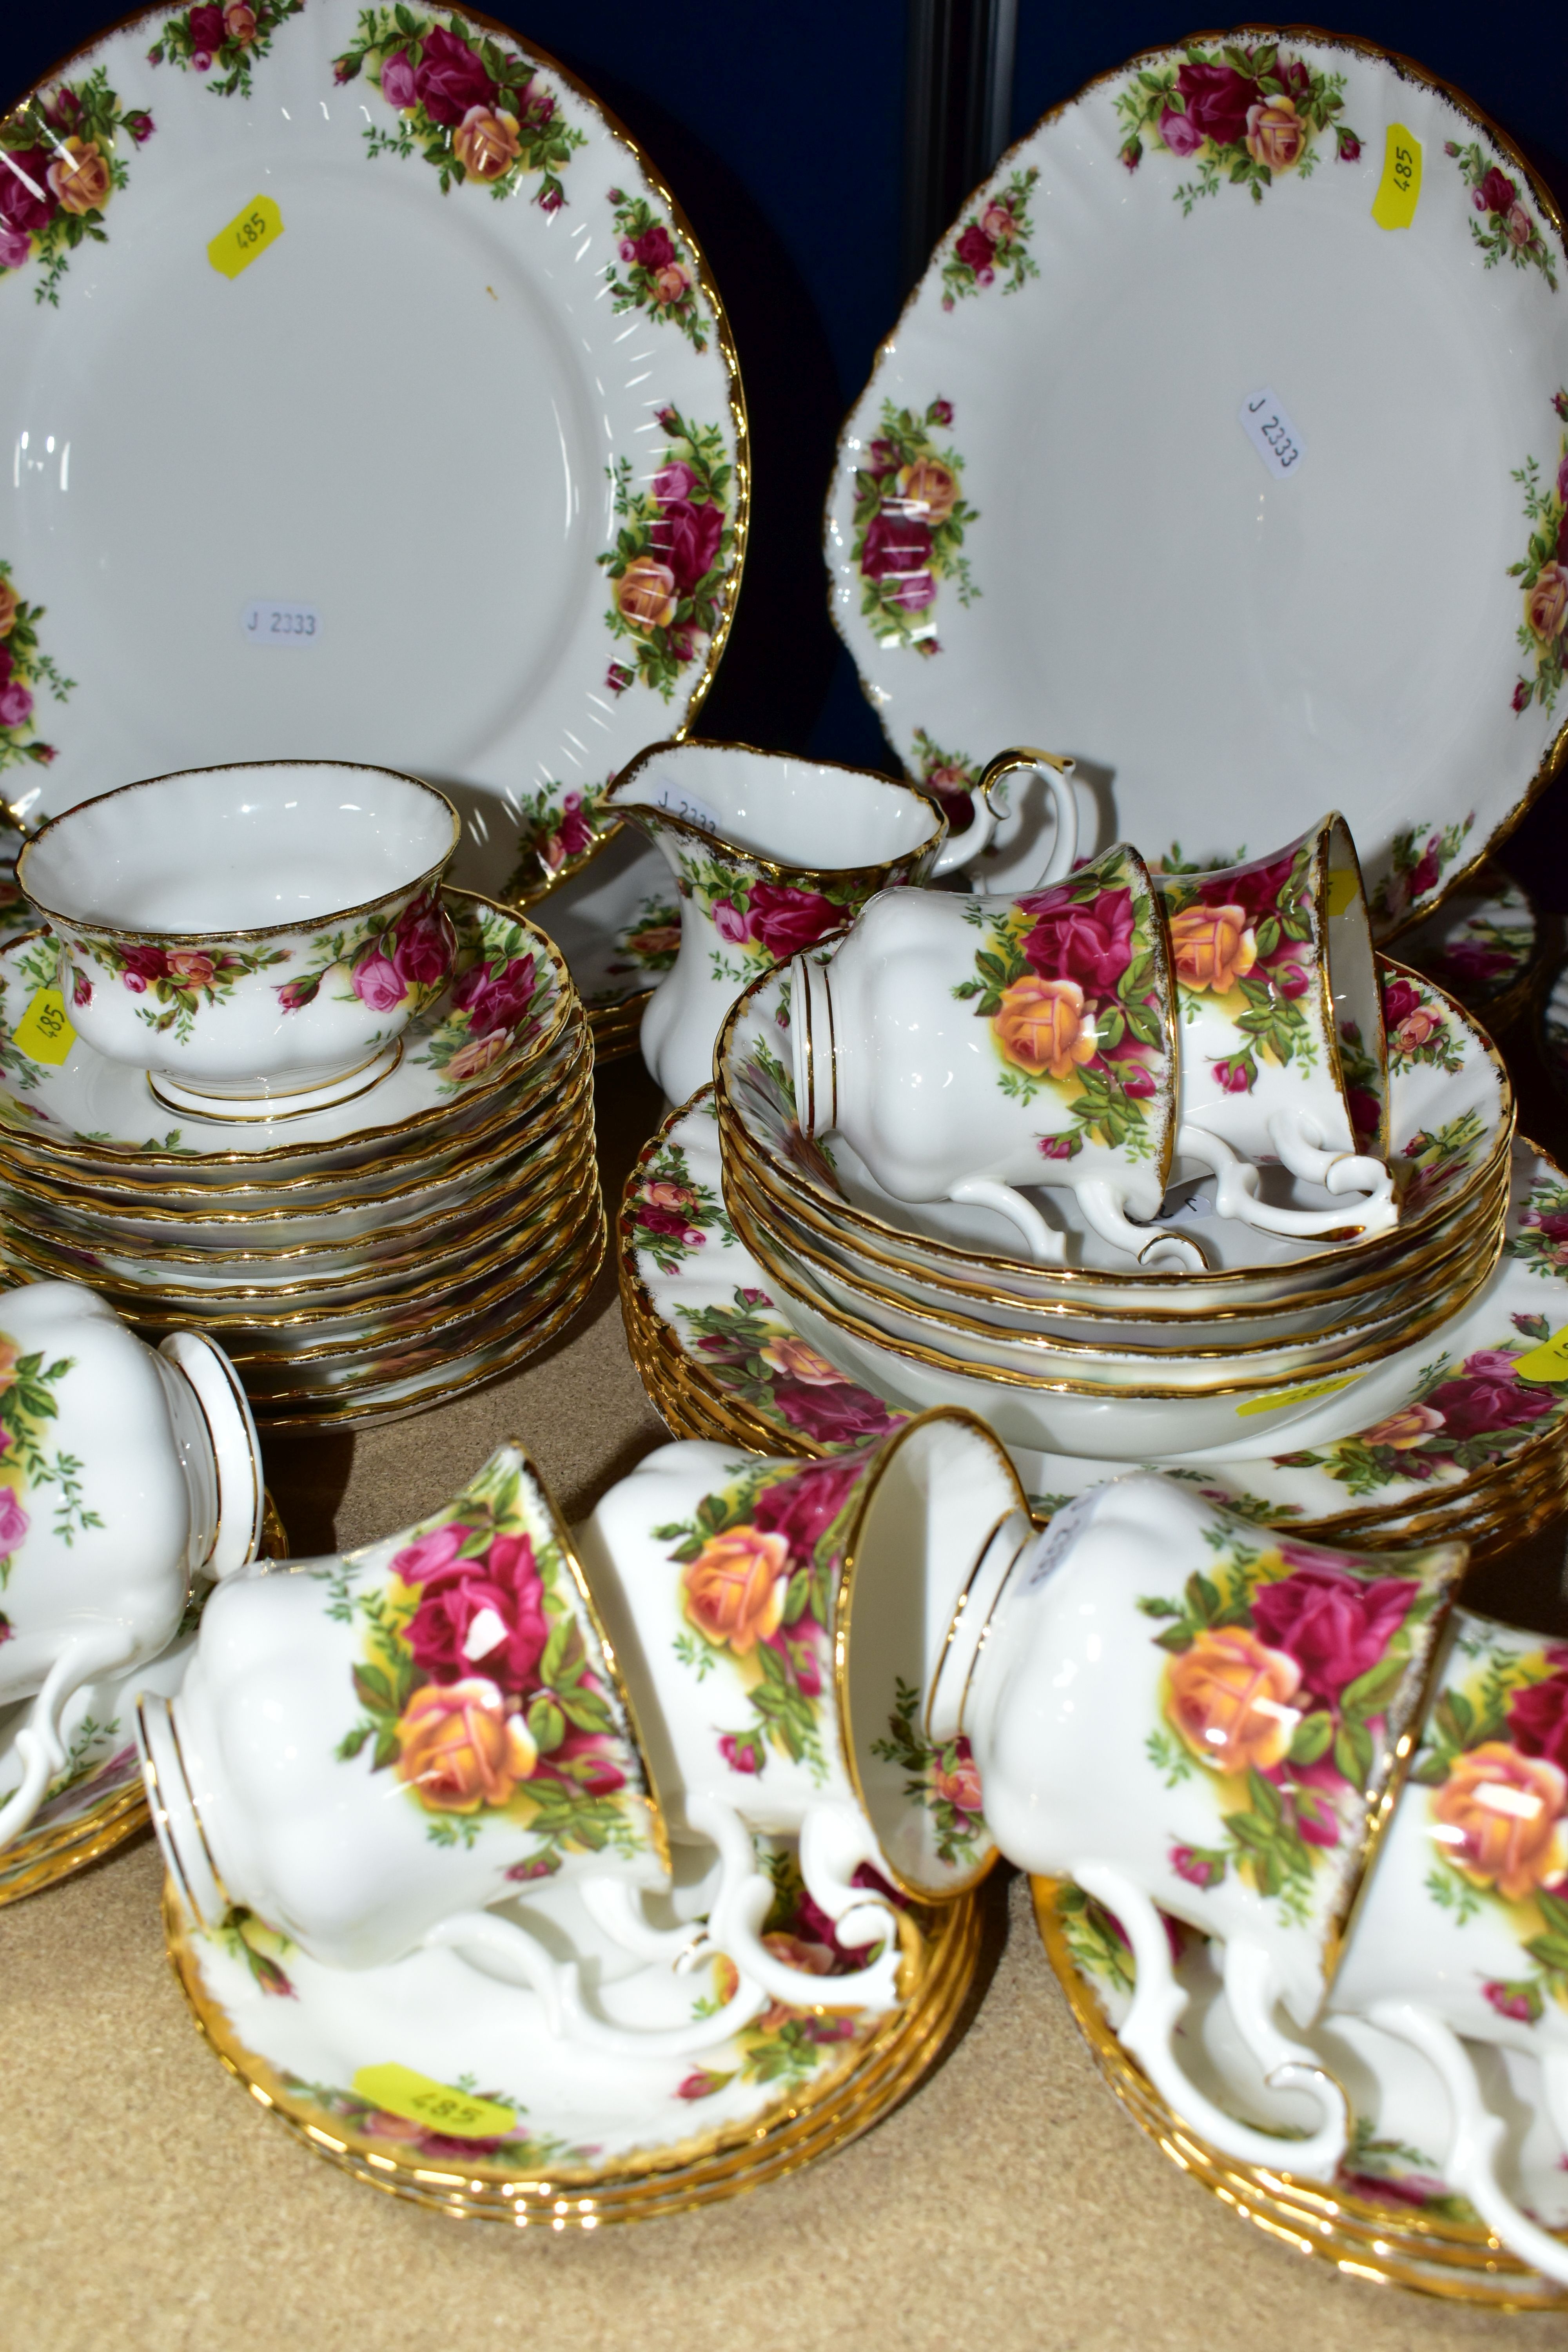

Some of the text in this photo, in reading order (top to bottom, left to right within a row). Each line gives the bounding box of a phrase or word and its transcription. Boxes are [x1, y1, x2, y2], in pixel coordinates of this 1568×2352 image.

[1393, 146, 1412, 192] 485
[236, 212, 265, 249] 485
[1249, 398, 1299, 468] J 2333
[248, 611, 316, 636] J 2333
[658, 791, 668, 808] J
[36, 1004, 65, 1038] 485
[410, 2092, 485, 2124] 485
